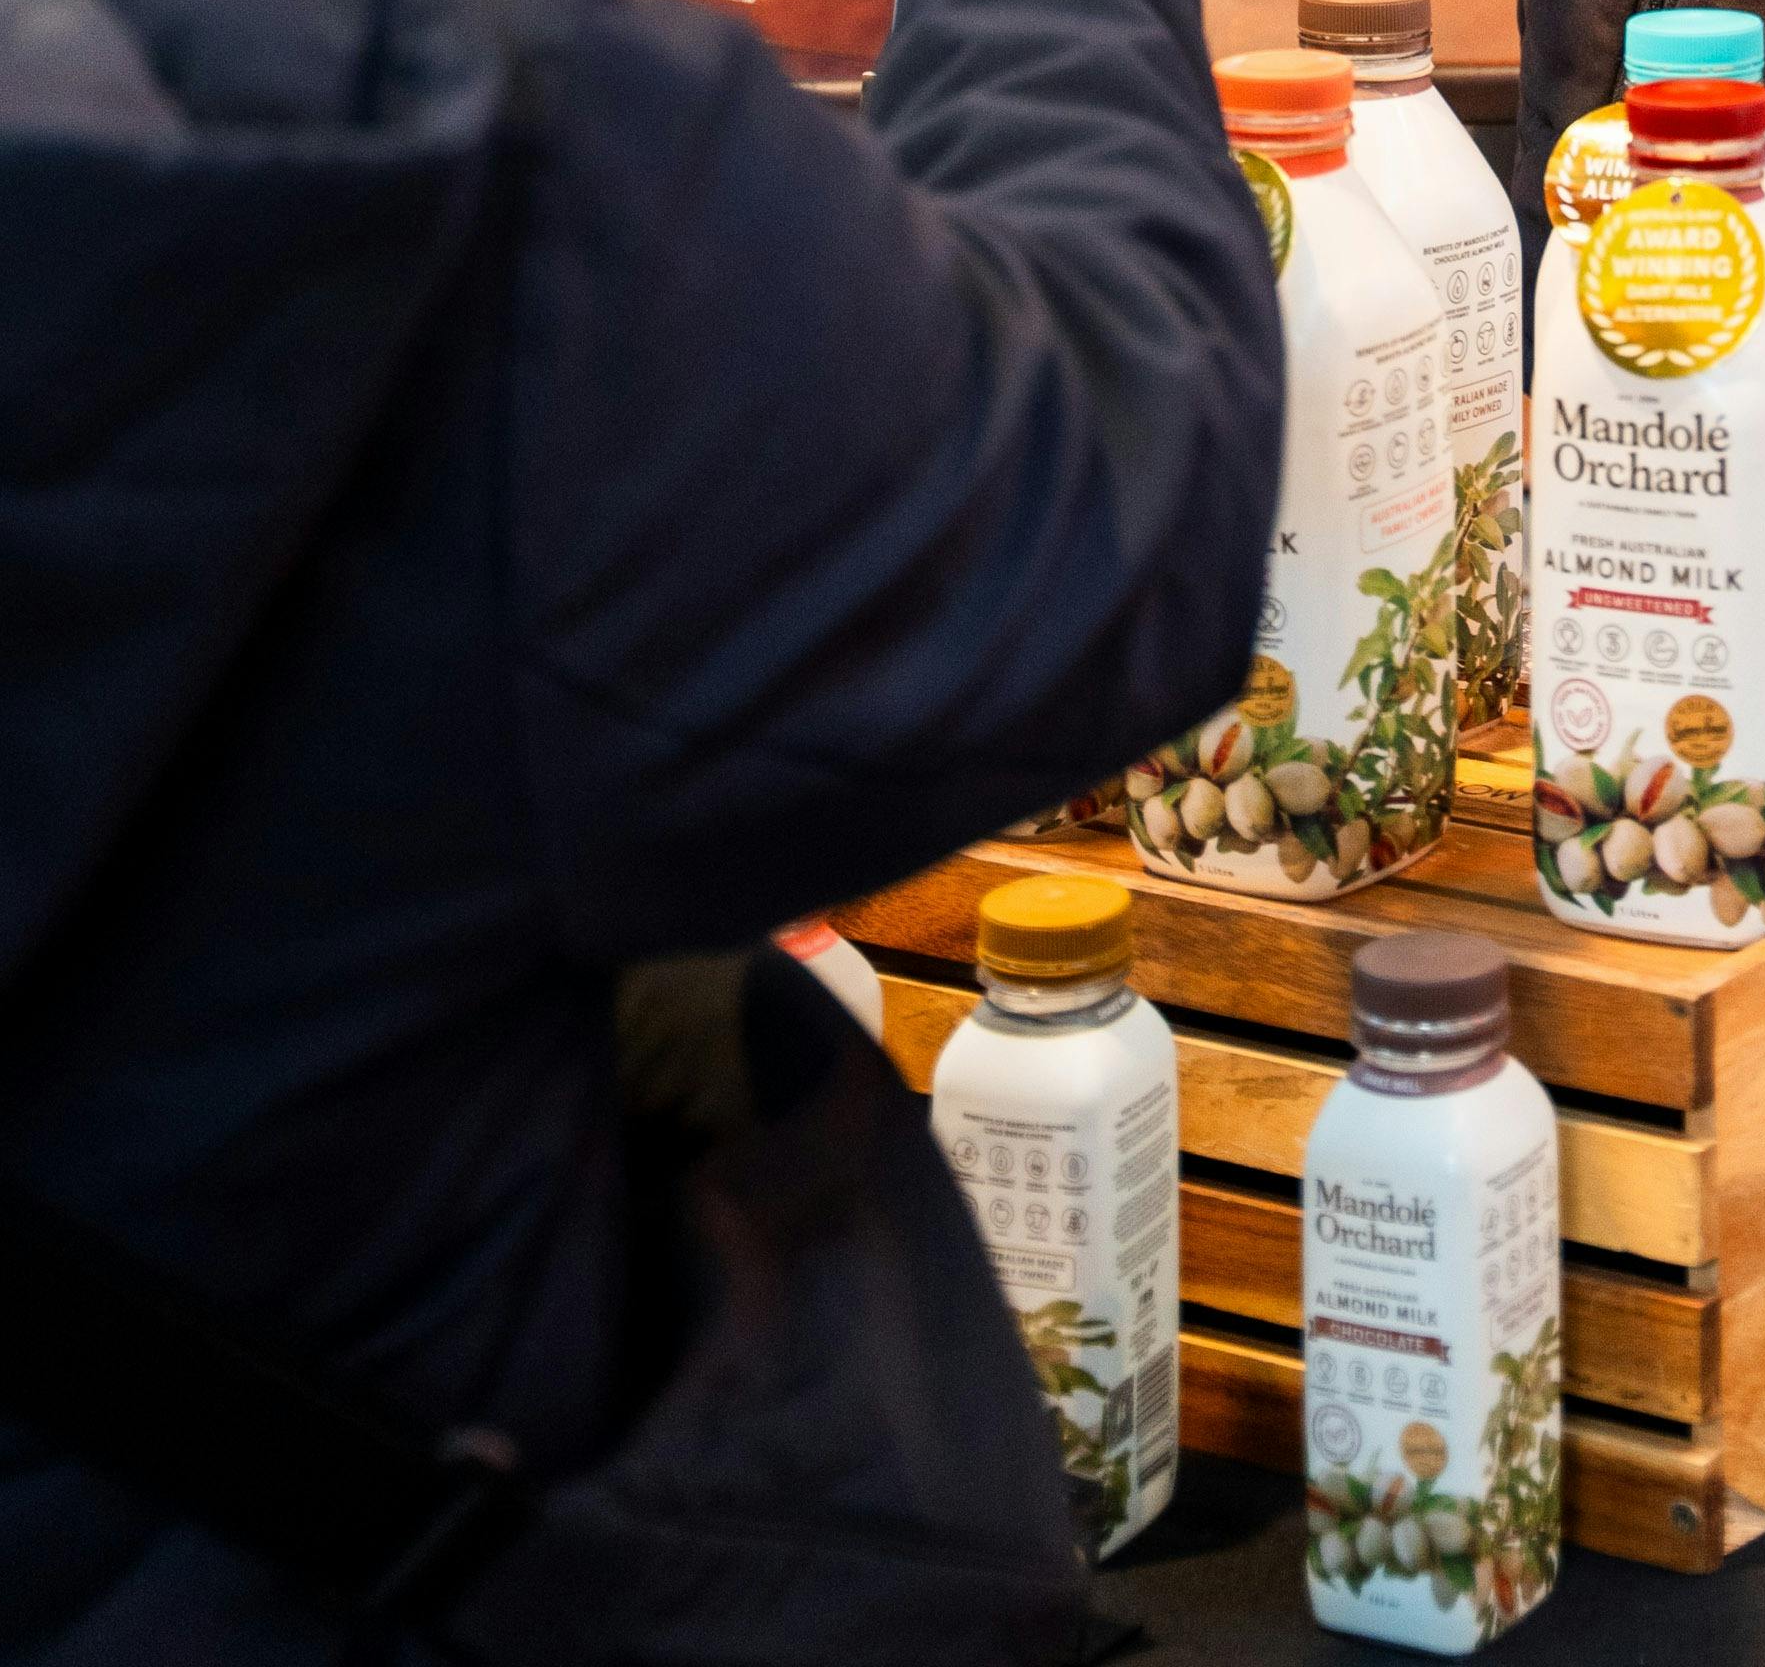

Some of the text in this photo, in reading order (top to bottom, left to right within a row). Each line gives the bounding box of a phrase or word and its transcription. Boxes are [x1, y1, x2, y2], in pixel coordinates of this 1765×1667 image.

[1625, 227, 1722, 250] AWARD
[1611, 254, 1733, 279] WINNING
[1453, 380, 1508, 408] RALIAN MADE
[1472, 399, 1502, 418] OWNED
[1554, 398, 1730, 452] Mandolé
[1554, 443, 1729, 496] Orchard
[1572, 534, 1706, 559] FRESH AUSTRALIAN
[1544, 548, 1743, 591] ALMOND MILK
[1584, 591, 1695, 615] UNSWEETENED
[1316, 1178, 1436, 1228] Mandolé
[1316, 1214, 1436, 1262] Orchard
[1316, 1291, 1438, 1327] ALMOND MILK
[1330, 1323, 1425, 1351] CHOCOLATE
